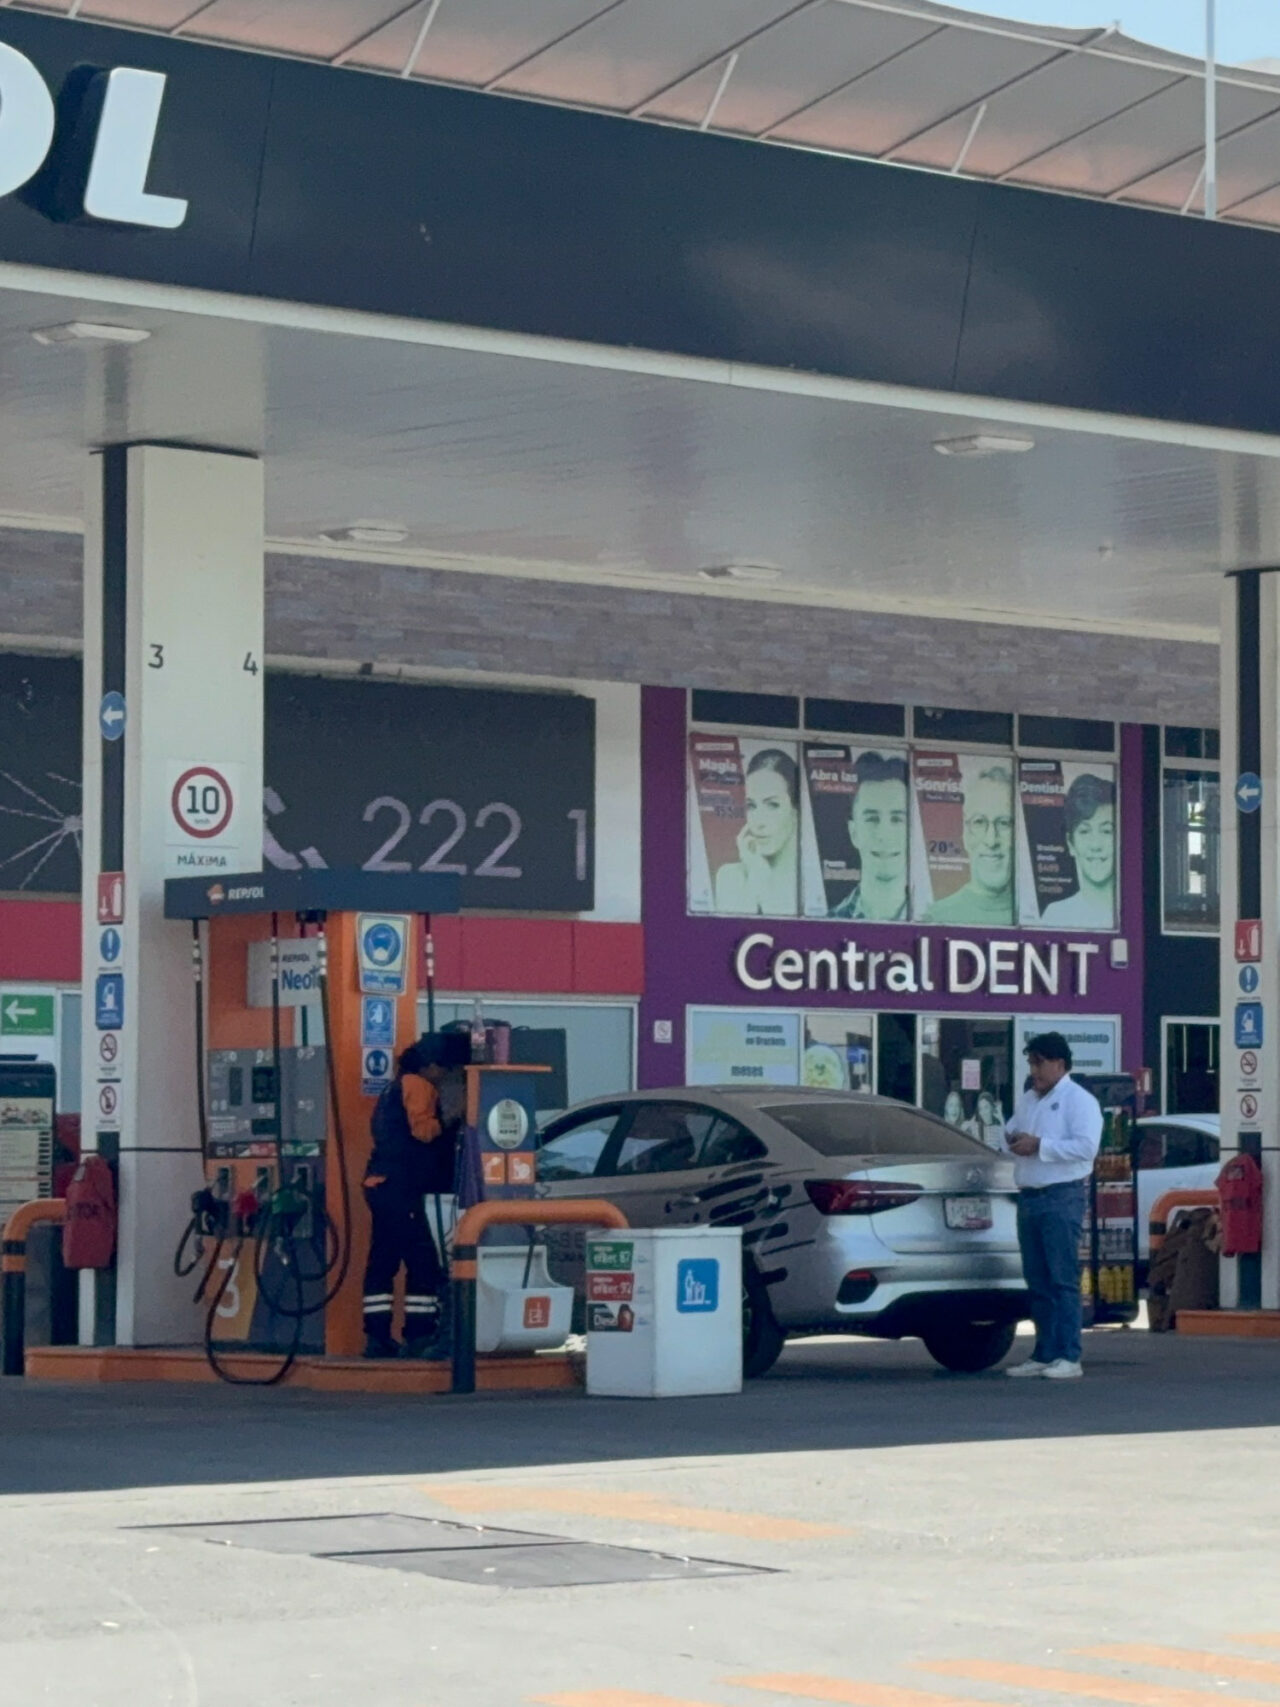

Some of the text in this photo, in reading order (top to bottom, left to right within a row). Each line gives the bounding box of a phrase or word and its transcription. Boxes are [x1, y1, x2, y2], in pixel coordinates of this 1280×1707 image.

[148, 644, 164, 669] 3
[242, 652, 258, 676] 4
[187, 785, 221, 815] 10
[362, 796, 587, 881] 222 1
[177, 851, 228, 867] MÁXIMA
[735, 933, 1099, 996] Central DENT
